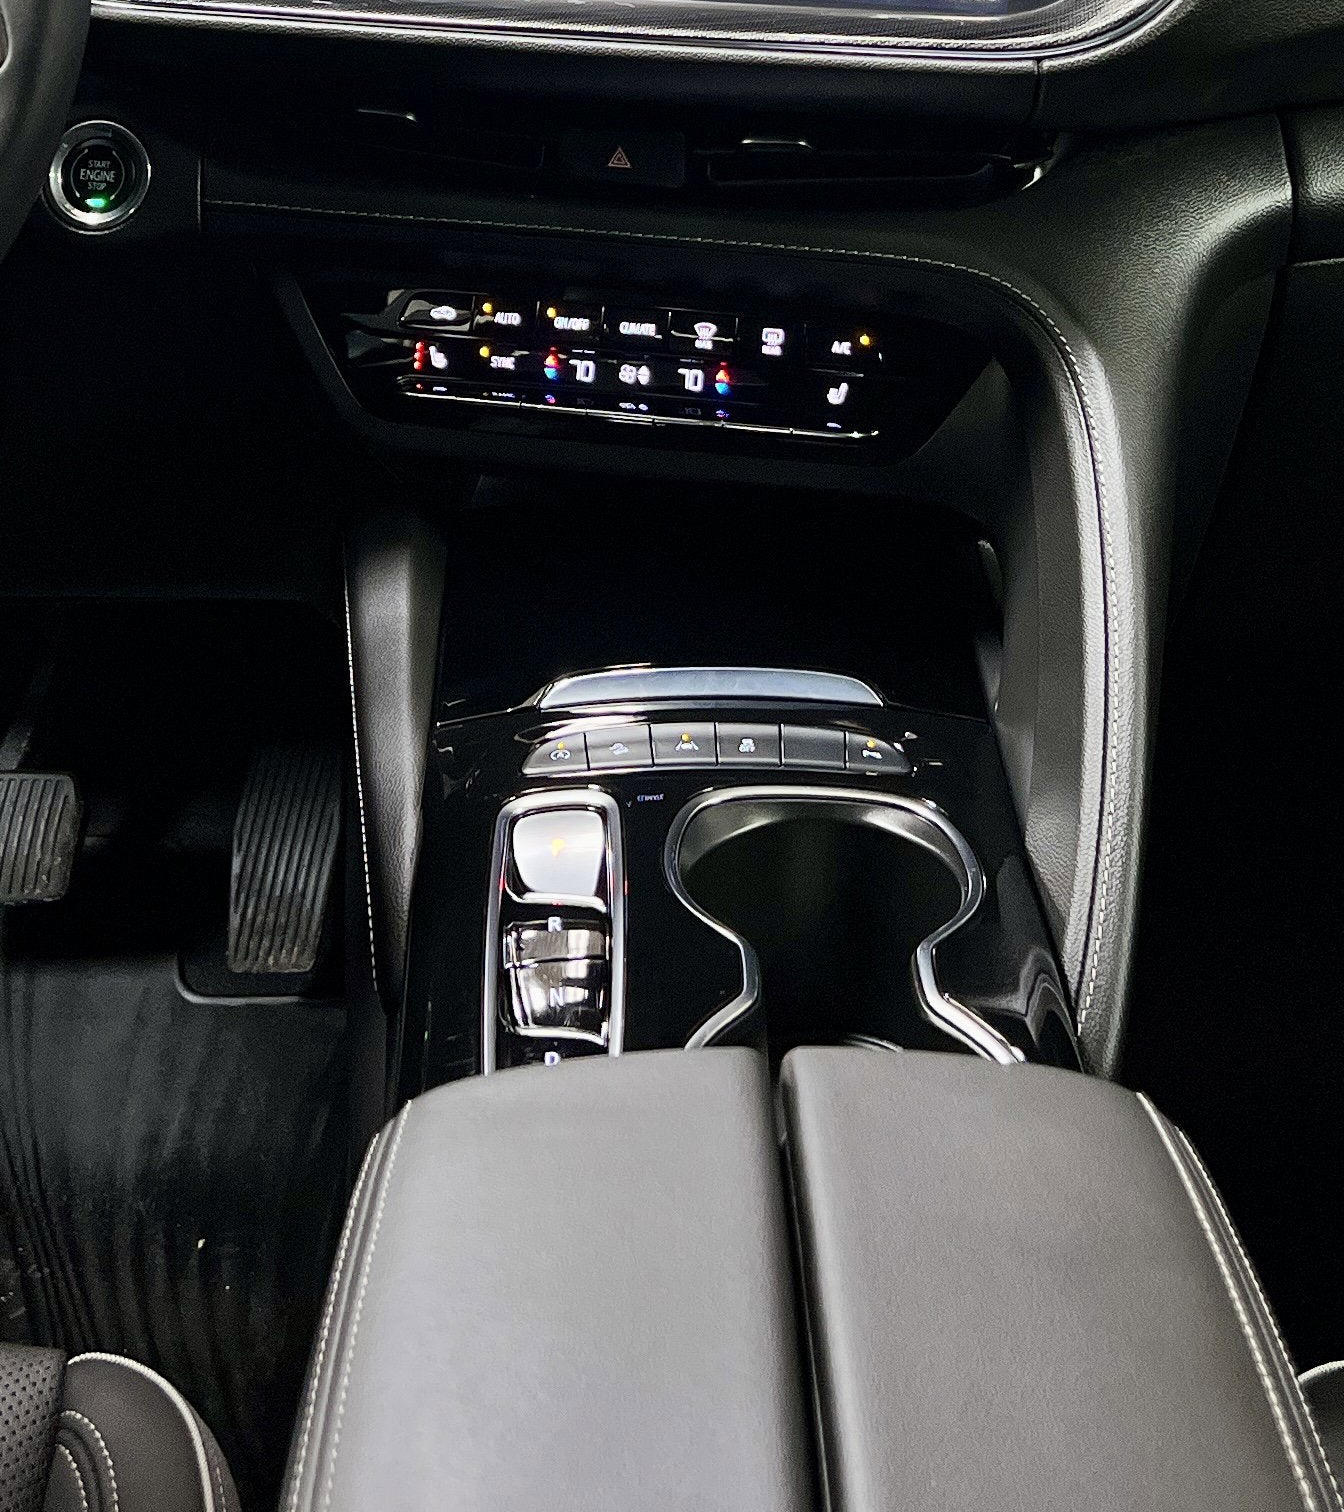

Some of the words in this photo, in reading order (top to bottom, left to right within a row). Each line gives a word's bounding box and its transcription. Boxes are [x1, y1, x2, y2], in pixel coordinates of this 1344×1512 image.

[88, 159, 111, 168] START
[79, 168, 116, 182] ENGINE
[87, 181, 107, 190] STOP
[494, 312, 522, 326] AUTO
[490, 355, 516, 370] SYNC
[569, 359, 596, 383] 70
[677, 368, 705, 392] 70
[551, 838, 565, 856] P
[547, 916, 563, 933] R
[549, 987, 564, 1007] N
[544, 1051, 561, 1067] D
